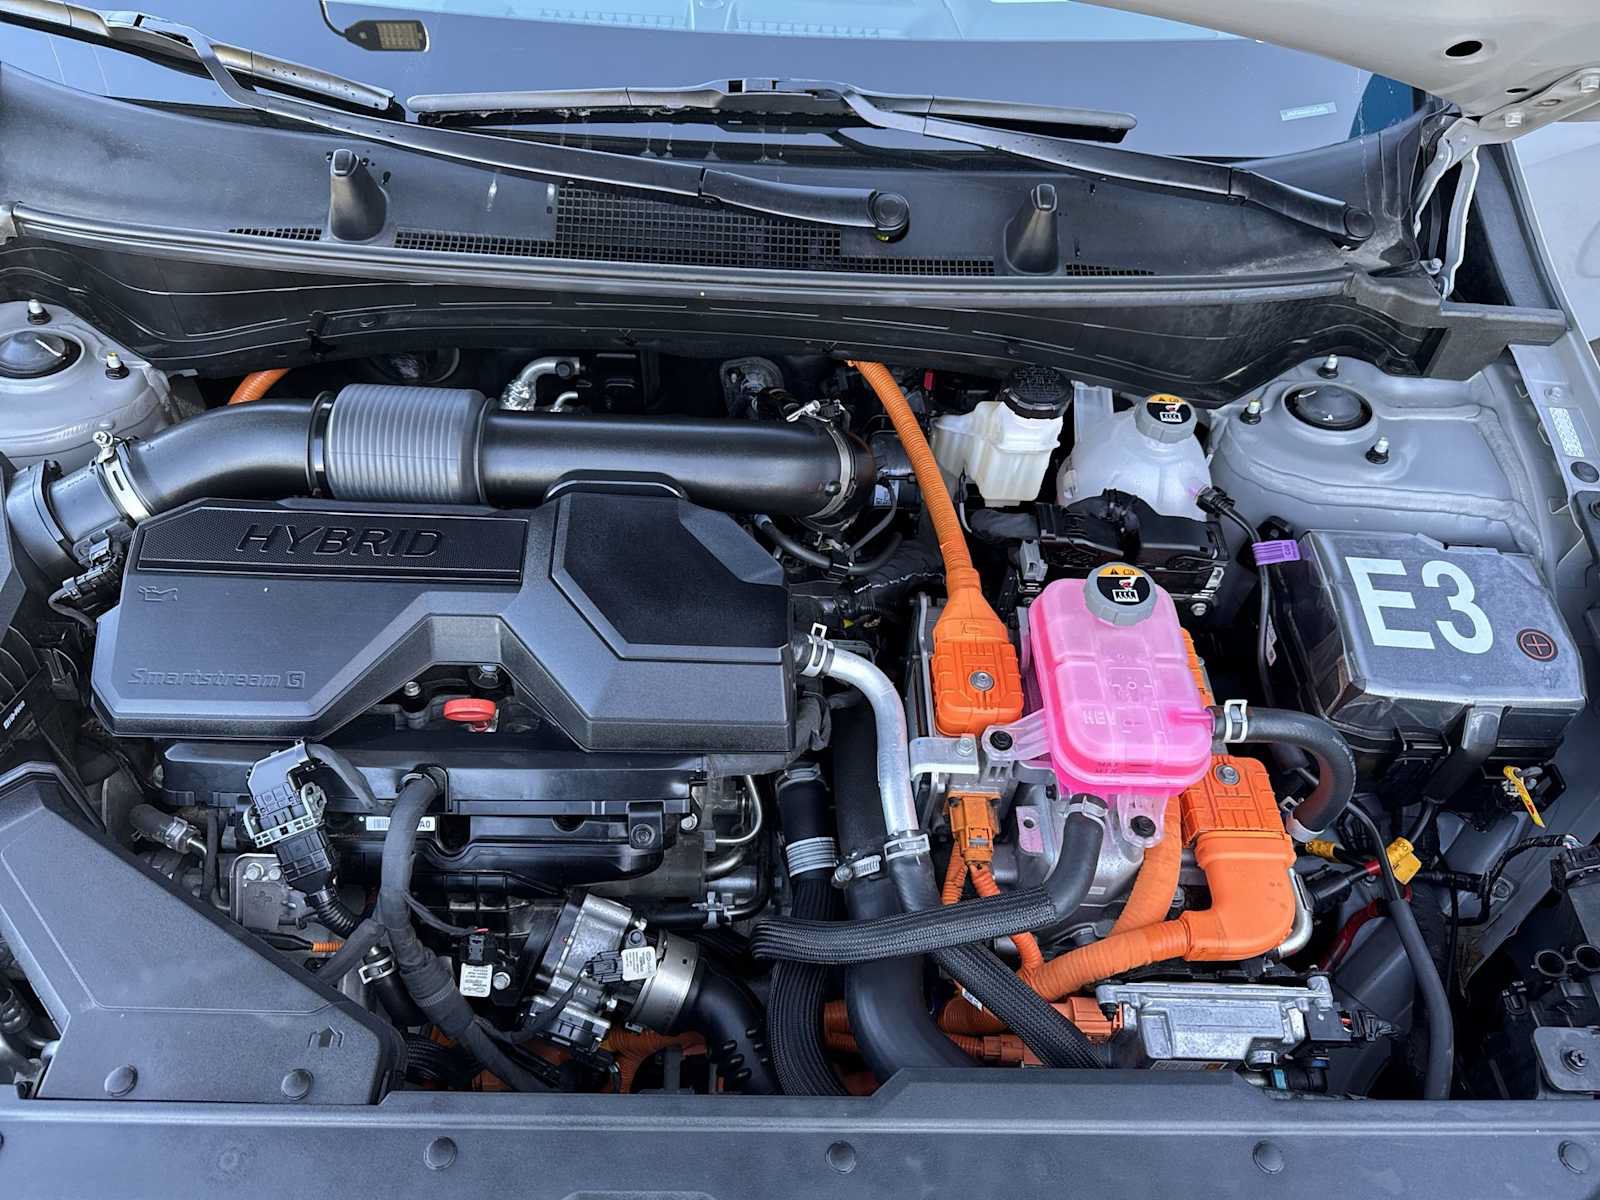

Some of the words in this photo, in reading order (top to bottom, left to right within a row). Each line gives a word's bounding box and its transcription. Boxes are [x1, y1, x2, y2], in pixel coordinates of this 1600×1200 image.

[235, 523, 443, 558] HYBRID
[1344, 556, 1494, 655] E3
[127, 668, 281, 690] Smartstream
